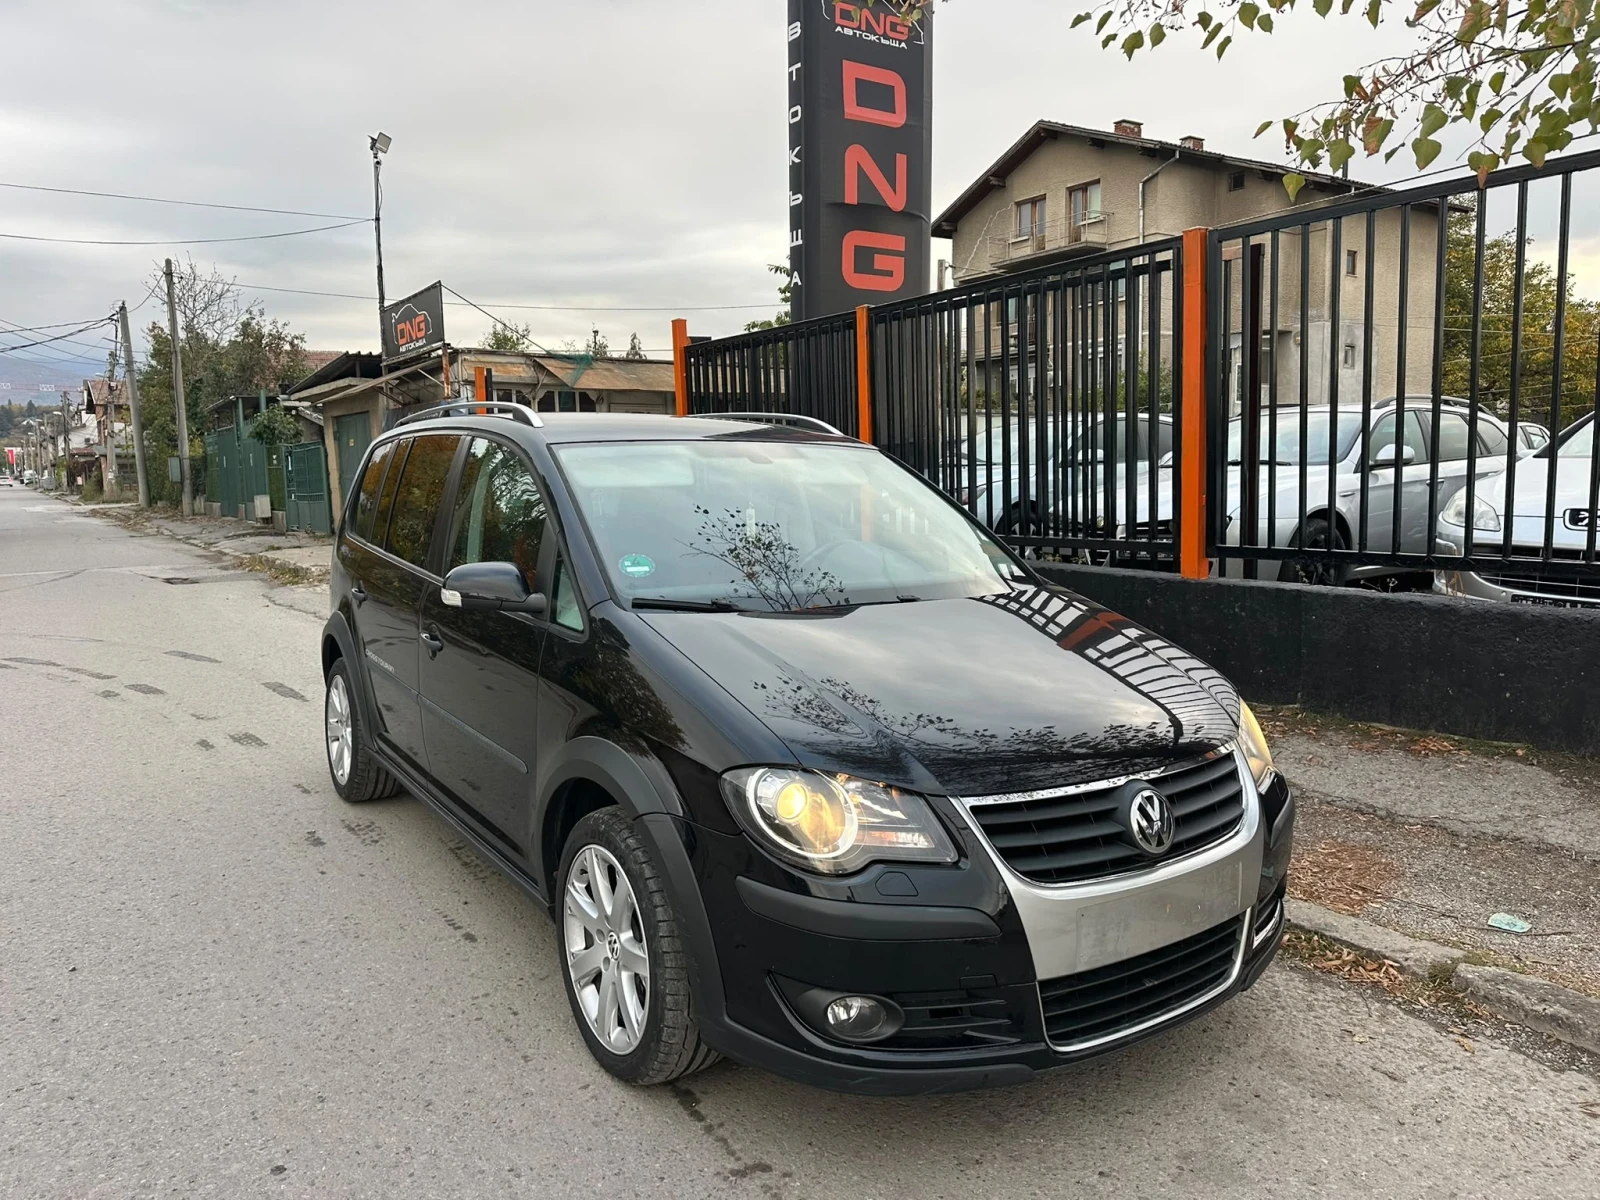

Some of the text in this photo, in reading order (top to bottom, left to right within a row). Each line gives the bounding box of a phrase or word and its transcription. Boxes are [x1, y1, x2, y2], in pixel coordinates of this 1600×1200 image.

[835, 2, 909, 41] DNG
[835, 26, 908, 49] АВТОКЪША
[841, 59, 908, 293] DNG
[397, 314, 426, 345] DNG
